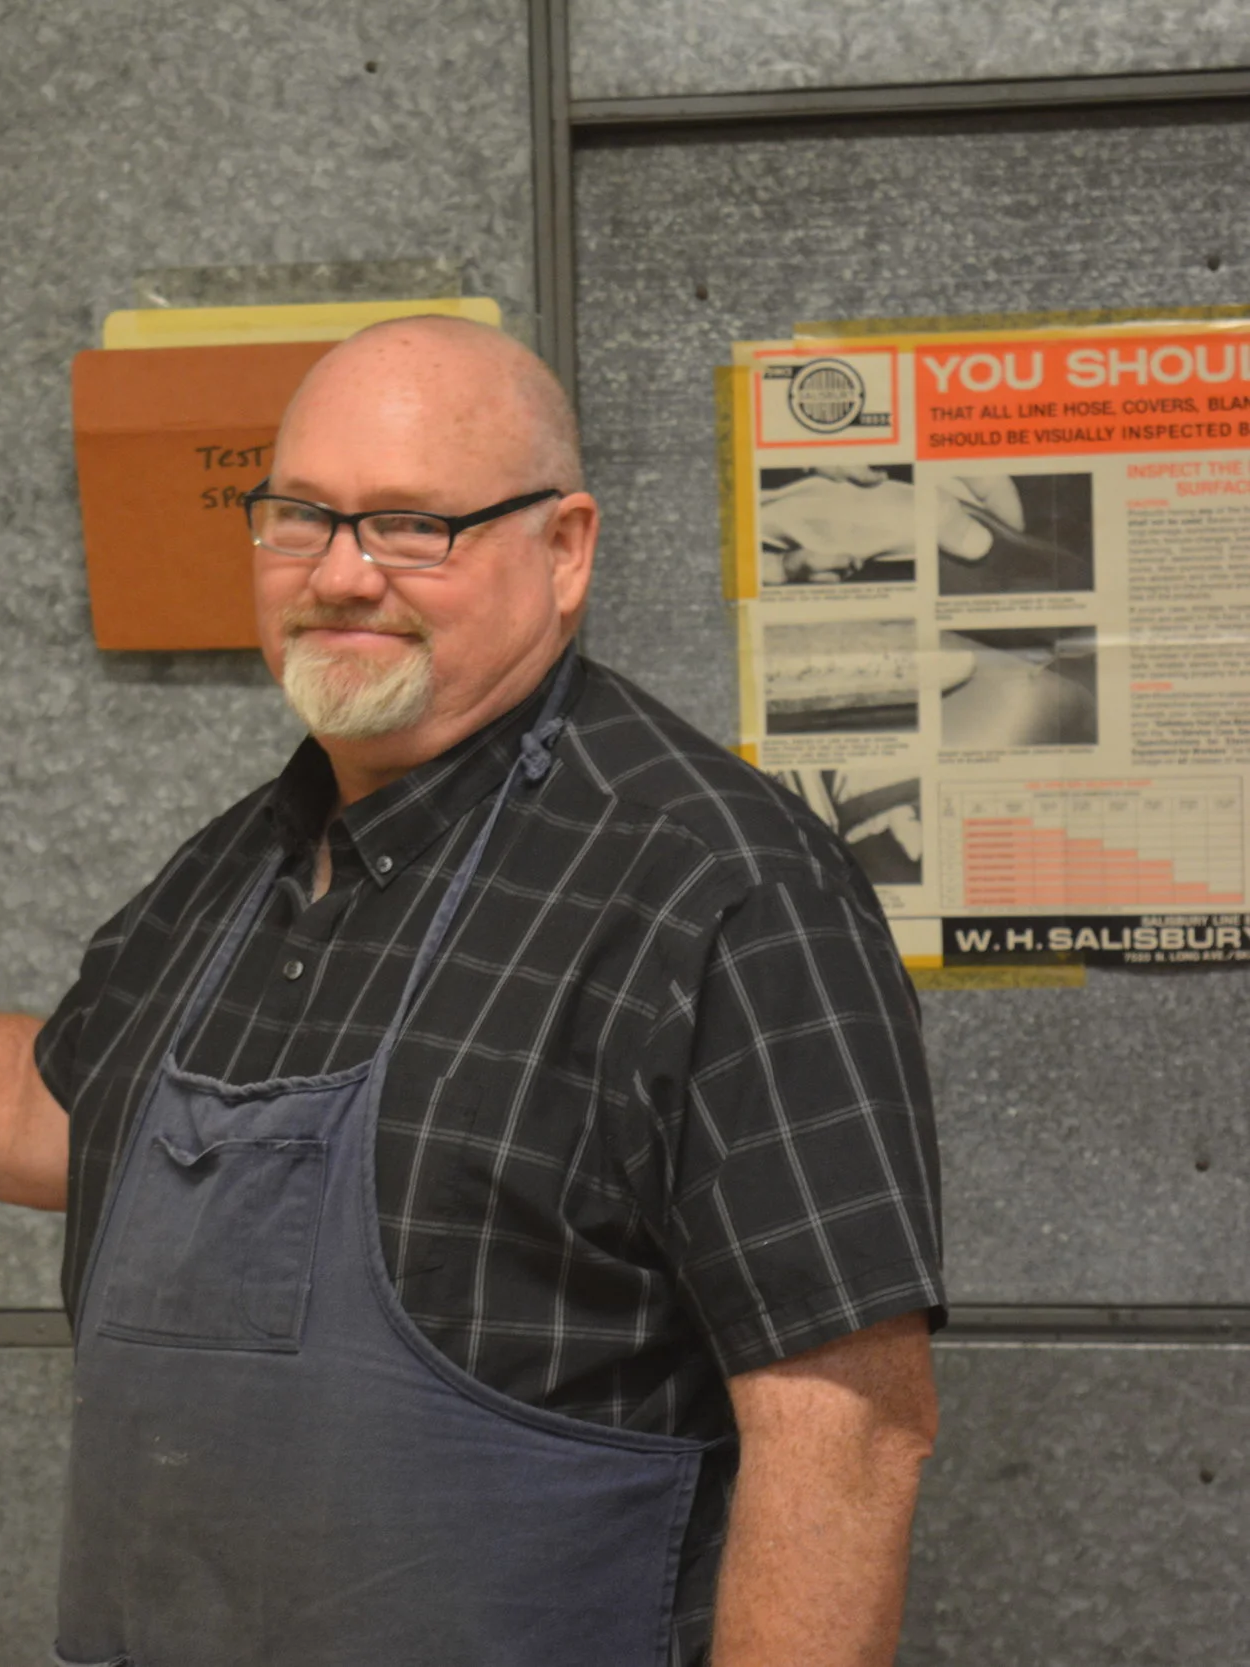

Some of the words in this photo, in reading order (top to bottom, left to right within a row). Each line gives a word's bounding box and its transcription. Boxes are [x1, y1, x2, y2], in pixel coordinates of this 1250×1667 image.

[922, 351, 1044, 393] YOU
[930, 405, 975, 422] THAT
[980, 403, 1012, 420] ALL
[1018, 401, 1060, 418] LINE
[1122, 396, 1200, 415] COVERS,
[929, 430, 1002, 448] SHOULD
[1006, 429, 1030, 446] BE
[1033, 425, 1115, 444] VISUALLY
[1122, 421, 1232, 441] INSPECTED
[1126, 461, 1202, 479] INSPECT
[1207, 460, 1243, 477] THE
